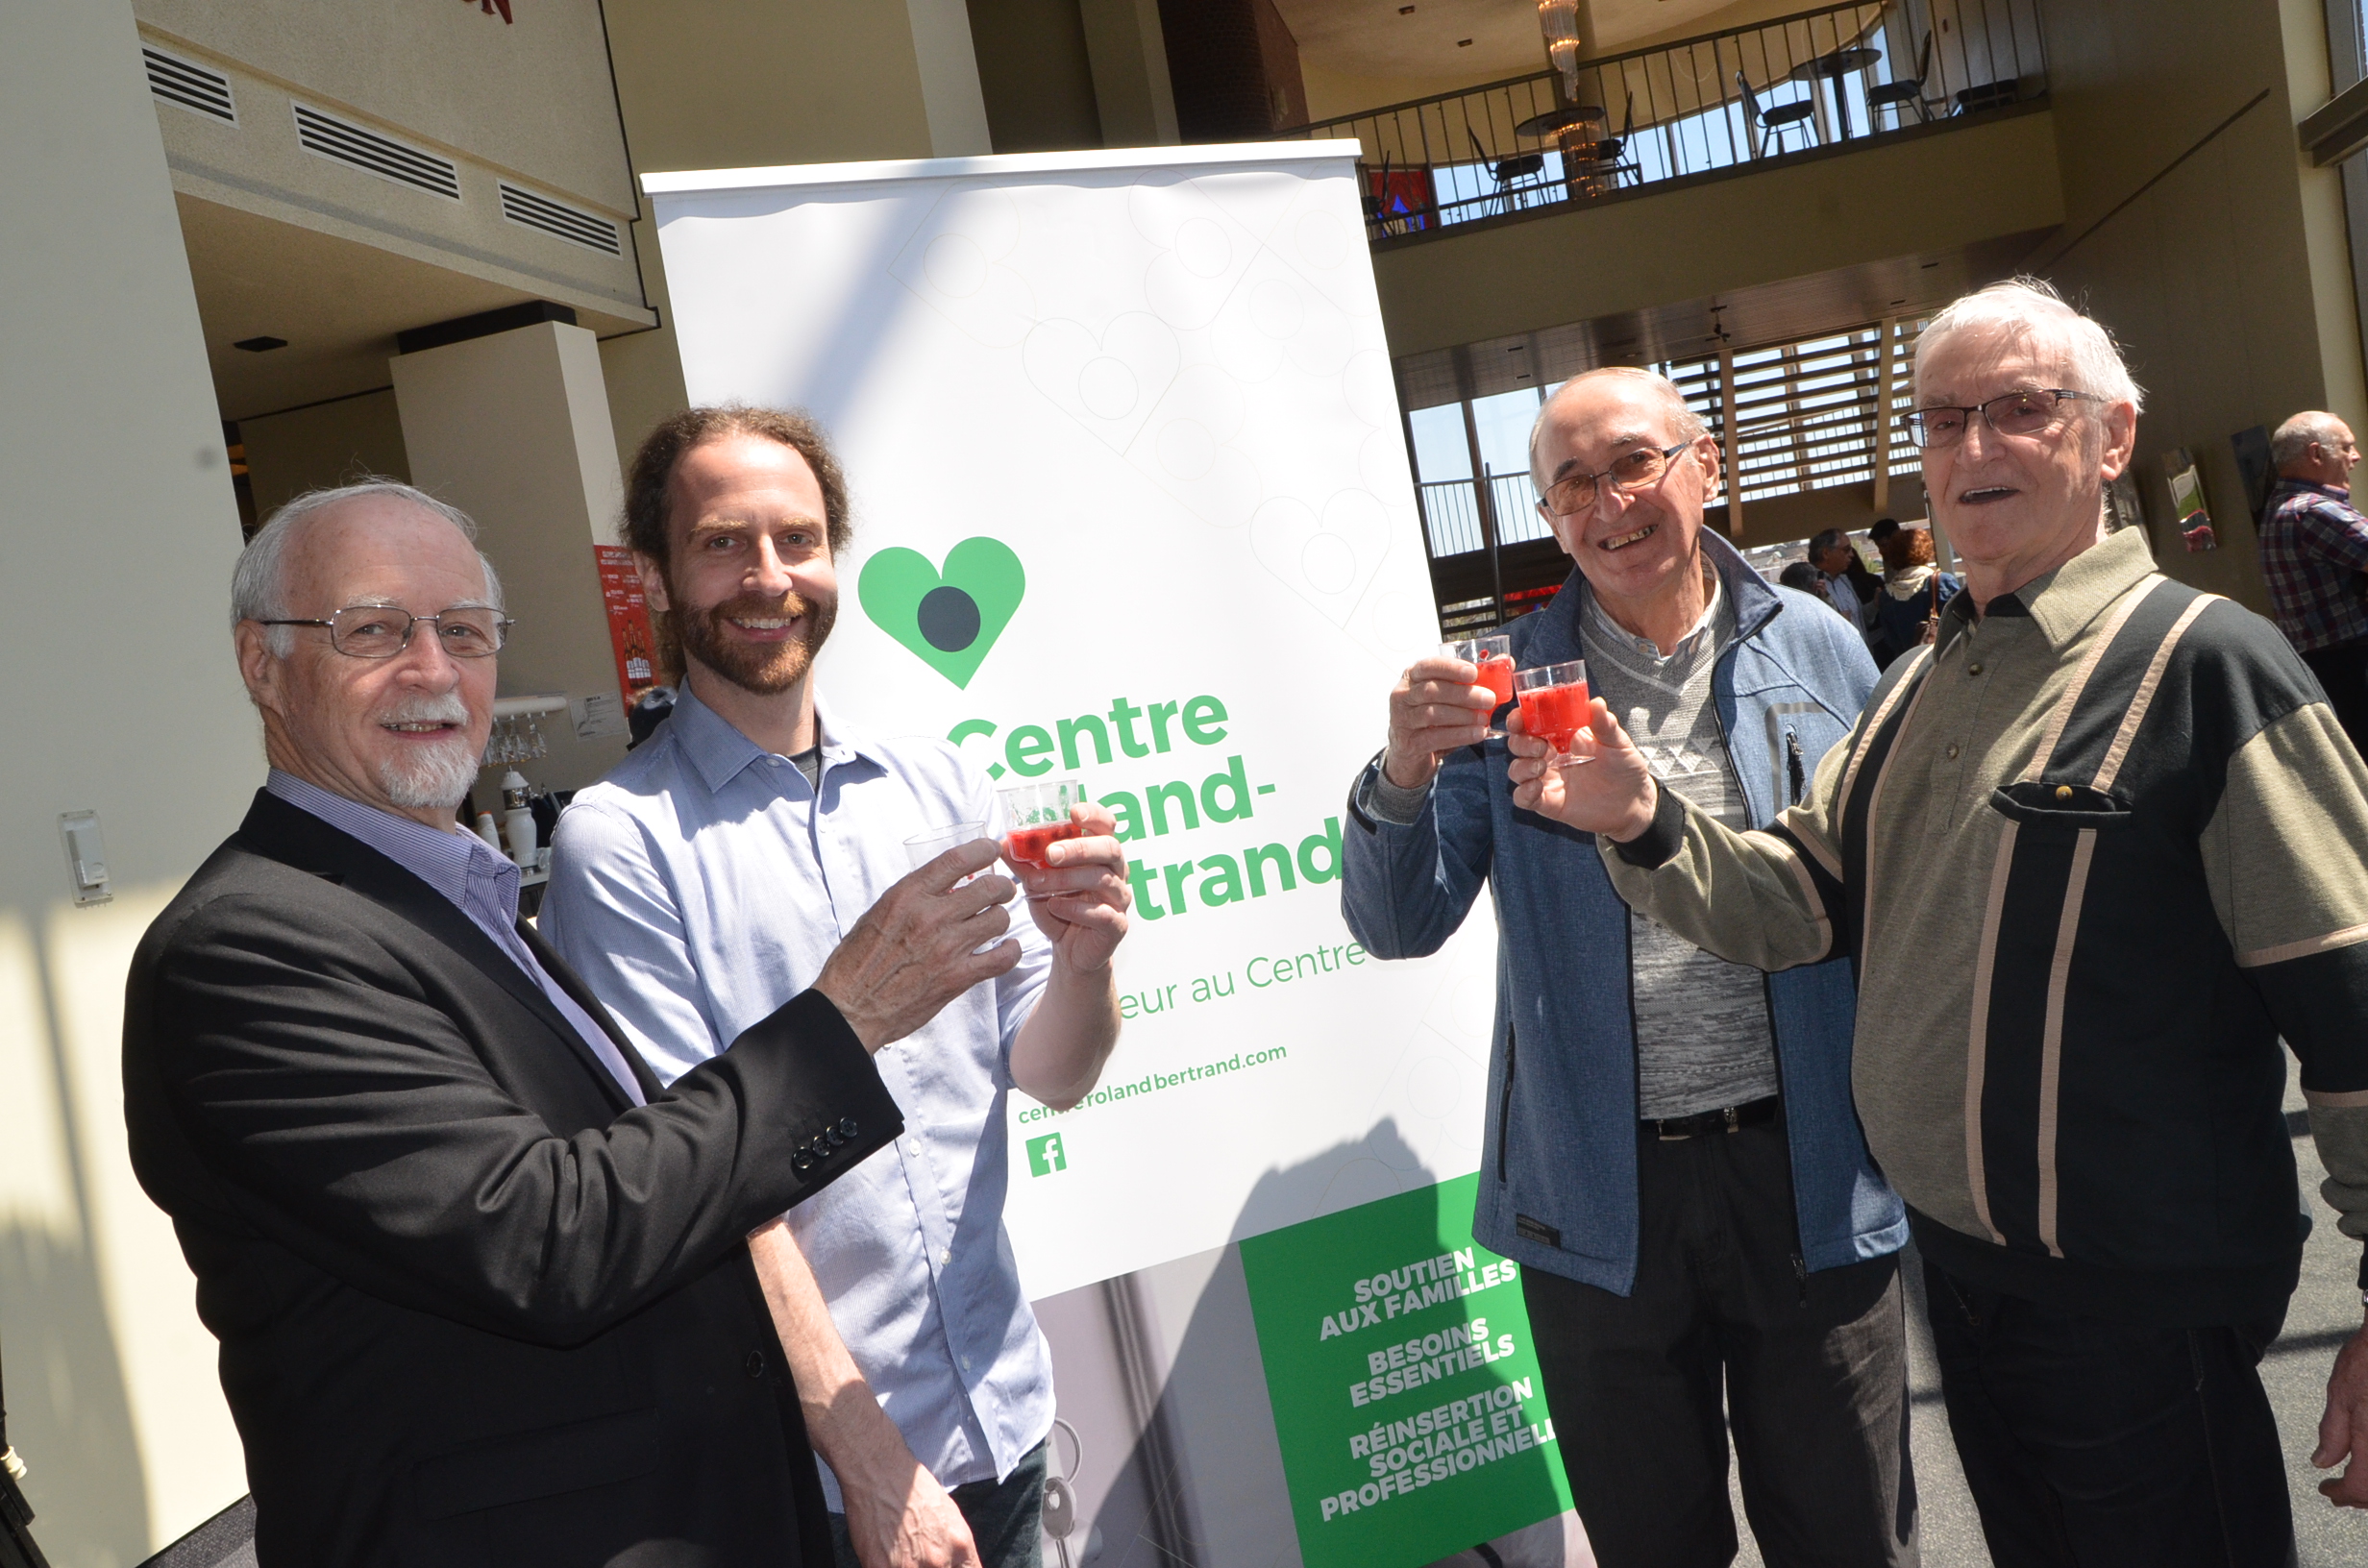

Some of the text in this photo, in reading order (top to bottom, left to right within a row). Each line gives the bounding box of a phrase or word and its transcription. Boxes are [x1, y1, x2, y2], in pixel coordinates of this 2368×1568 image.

[1126, 816, 1343, 921] trand
[1118, 941, 1366, 1019] eur au Centre
[1320, 1259, 1517, 1342] AUX FAMILLES
[1353, 1246, 1475, 1303] SOUTIEN
[1349, 1334, 1516, 1408] ESSENTIELS
[1367, 1317, 1489, 1376] BESOINS
[1349, 1376, 1534, 1459] RÉINSERTION
[1369, 1404, 1523, 1478] SOCIALE ET
[1320, 1417, 1557, 1523] PROFESSIONNELL
